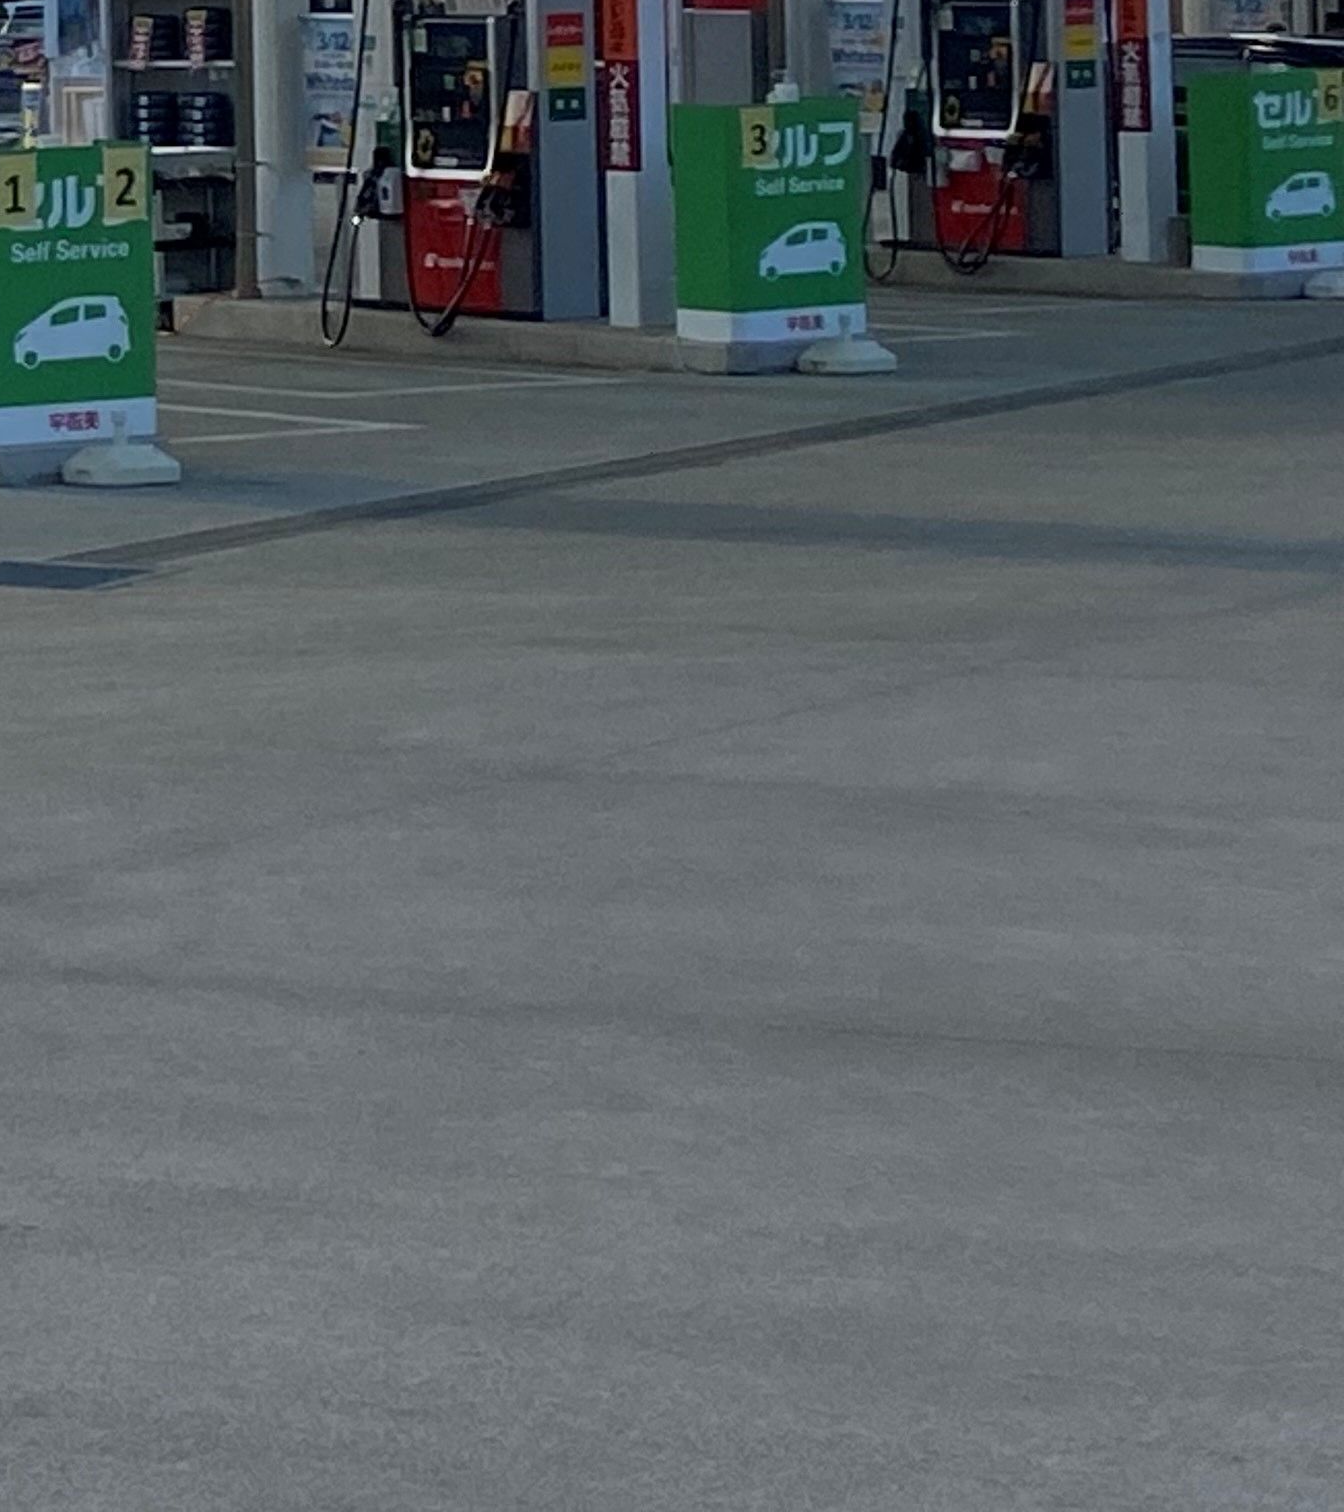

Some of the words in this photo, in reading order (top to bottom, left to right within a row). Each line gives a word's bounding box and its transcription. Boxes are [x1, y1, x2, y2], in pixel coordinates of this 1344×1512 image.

[1253, 88, 1329, 128] セル
[1324, 84, 1338, 111] 6
[750, 123, 767, 156] 3
[4, 174, 26, 215] 1
[115, 167, 137, 207] 2
[10, 240, 50, 264] Self
[55, 238, 130, 261] Service
